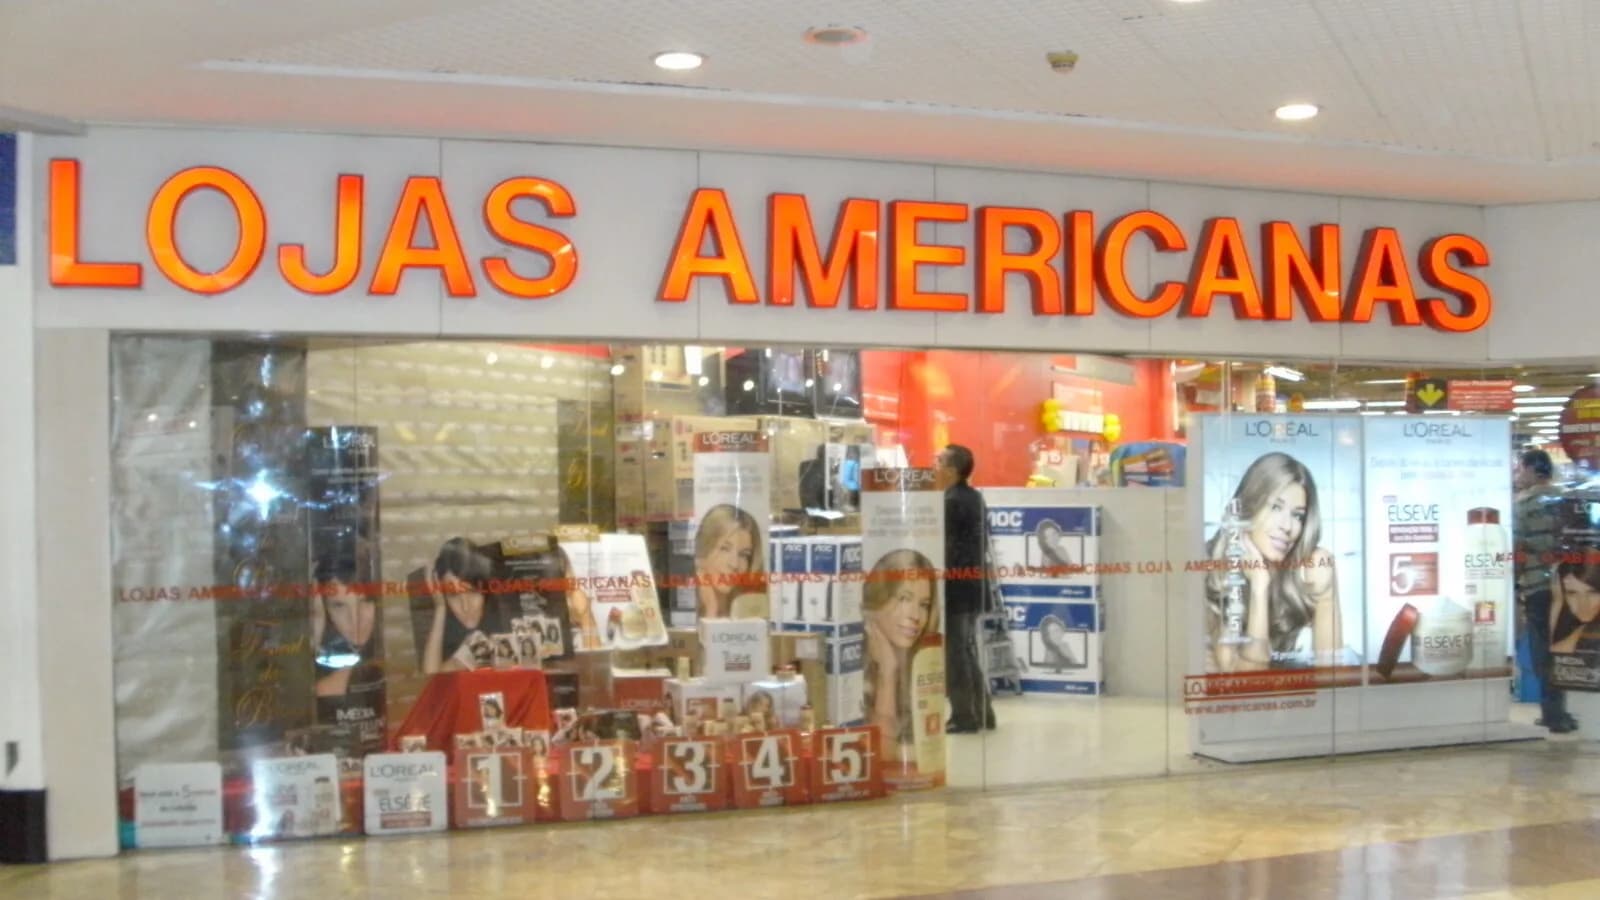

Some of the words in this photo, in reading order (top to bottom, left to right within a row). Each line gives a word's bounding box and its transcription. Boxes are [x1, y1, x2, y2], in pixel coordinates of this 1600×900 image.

[49, 158, 577, 298] LOJAS
[655, 187, 1491, 332] AMERICANAS
[1388, 504, 1440, 521] ELSEVE
[119, 586, 181, 602] LOJAS
[1391, 556, 1417, 594] 5
[1423, 634, 1463, 649] ELSEVE
[477, 752, 502, 808] 1
[581, 746, 621, 800] 2
[673, 740, 706, 794] 3
[752, 736, 785, 787] 4
[832, 732, 862, 784] 5
